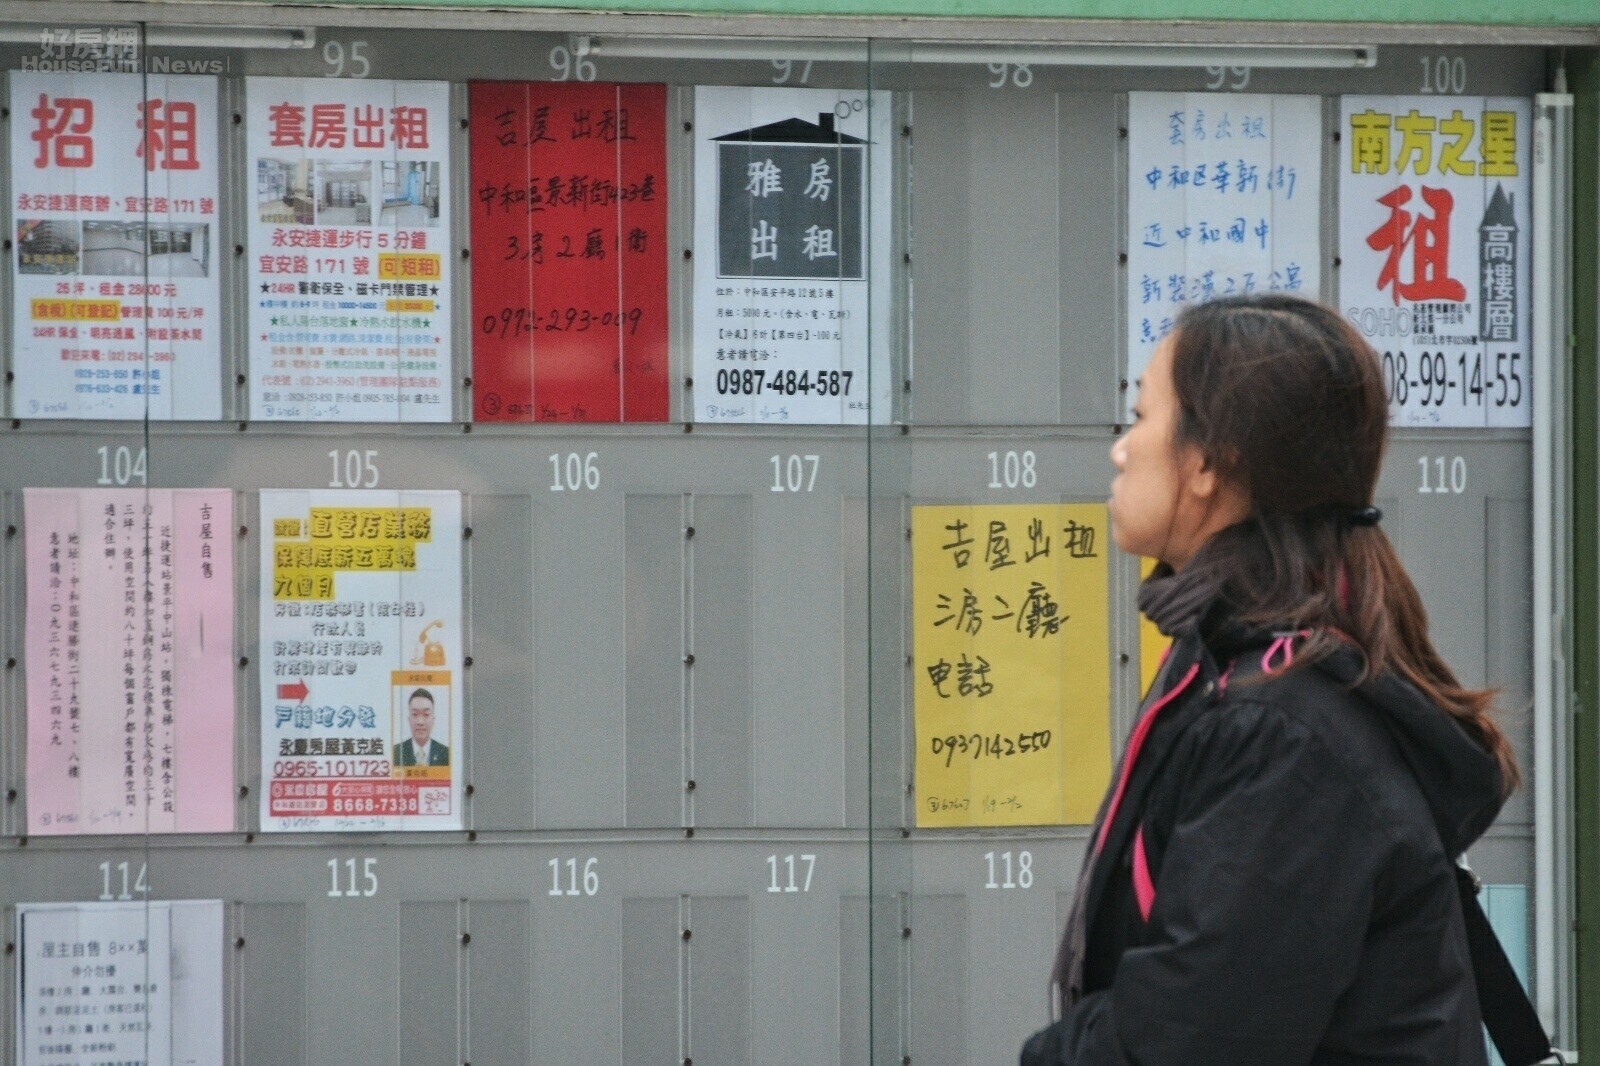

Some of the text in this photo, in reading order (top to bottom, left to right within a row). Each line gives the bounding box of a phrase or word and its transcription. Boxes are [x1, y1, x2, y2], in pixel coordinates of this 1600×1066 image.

[322, 40, 371, 78] 95
[549, 45, 597, 82] 96
[1420, 55, 1466, 93] 100
[31, 92, 200, 171] 招租
[268, 101, 429, 150] 套房出租
[1351, 109, 1518, 177] 南方之星
[745, 157, 833, 202] 雅房
[751, 219, 837, 260] 出租
[1365, 183, 1468, 308] 租
[1483, 223, 1514, 341] 高樓層
[1348, 307, 1412, 338] SOHO
[717, 368, 853, 396] 0987-484-587
[97, 446, 147, 486] 104
[328, 450, 380, 488] 105
[549, 452, 600, 491] 106
[770, 454, 820, 492] 107
[987, 450, 1037, 489] 108
[1418, 456, 1467, 494] 110
[941, 517, 1098, 572] 吉屋出租
[933, 581, 1071, 639] 三房二廳
[927, 653, 994, 699] 電話
[273, 760, 391, 778] 0965-101723
[98, 861, 151, 901] 114
[327, 857, 379, 897] 115
[547, 857, 599, 896] 116
[766, 854, 817, 894] 117
[983, 850, 1034, 890] 118
